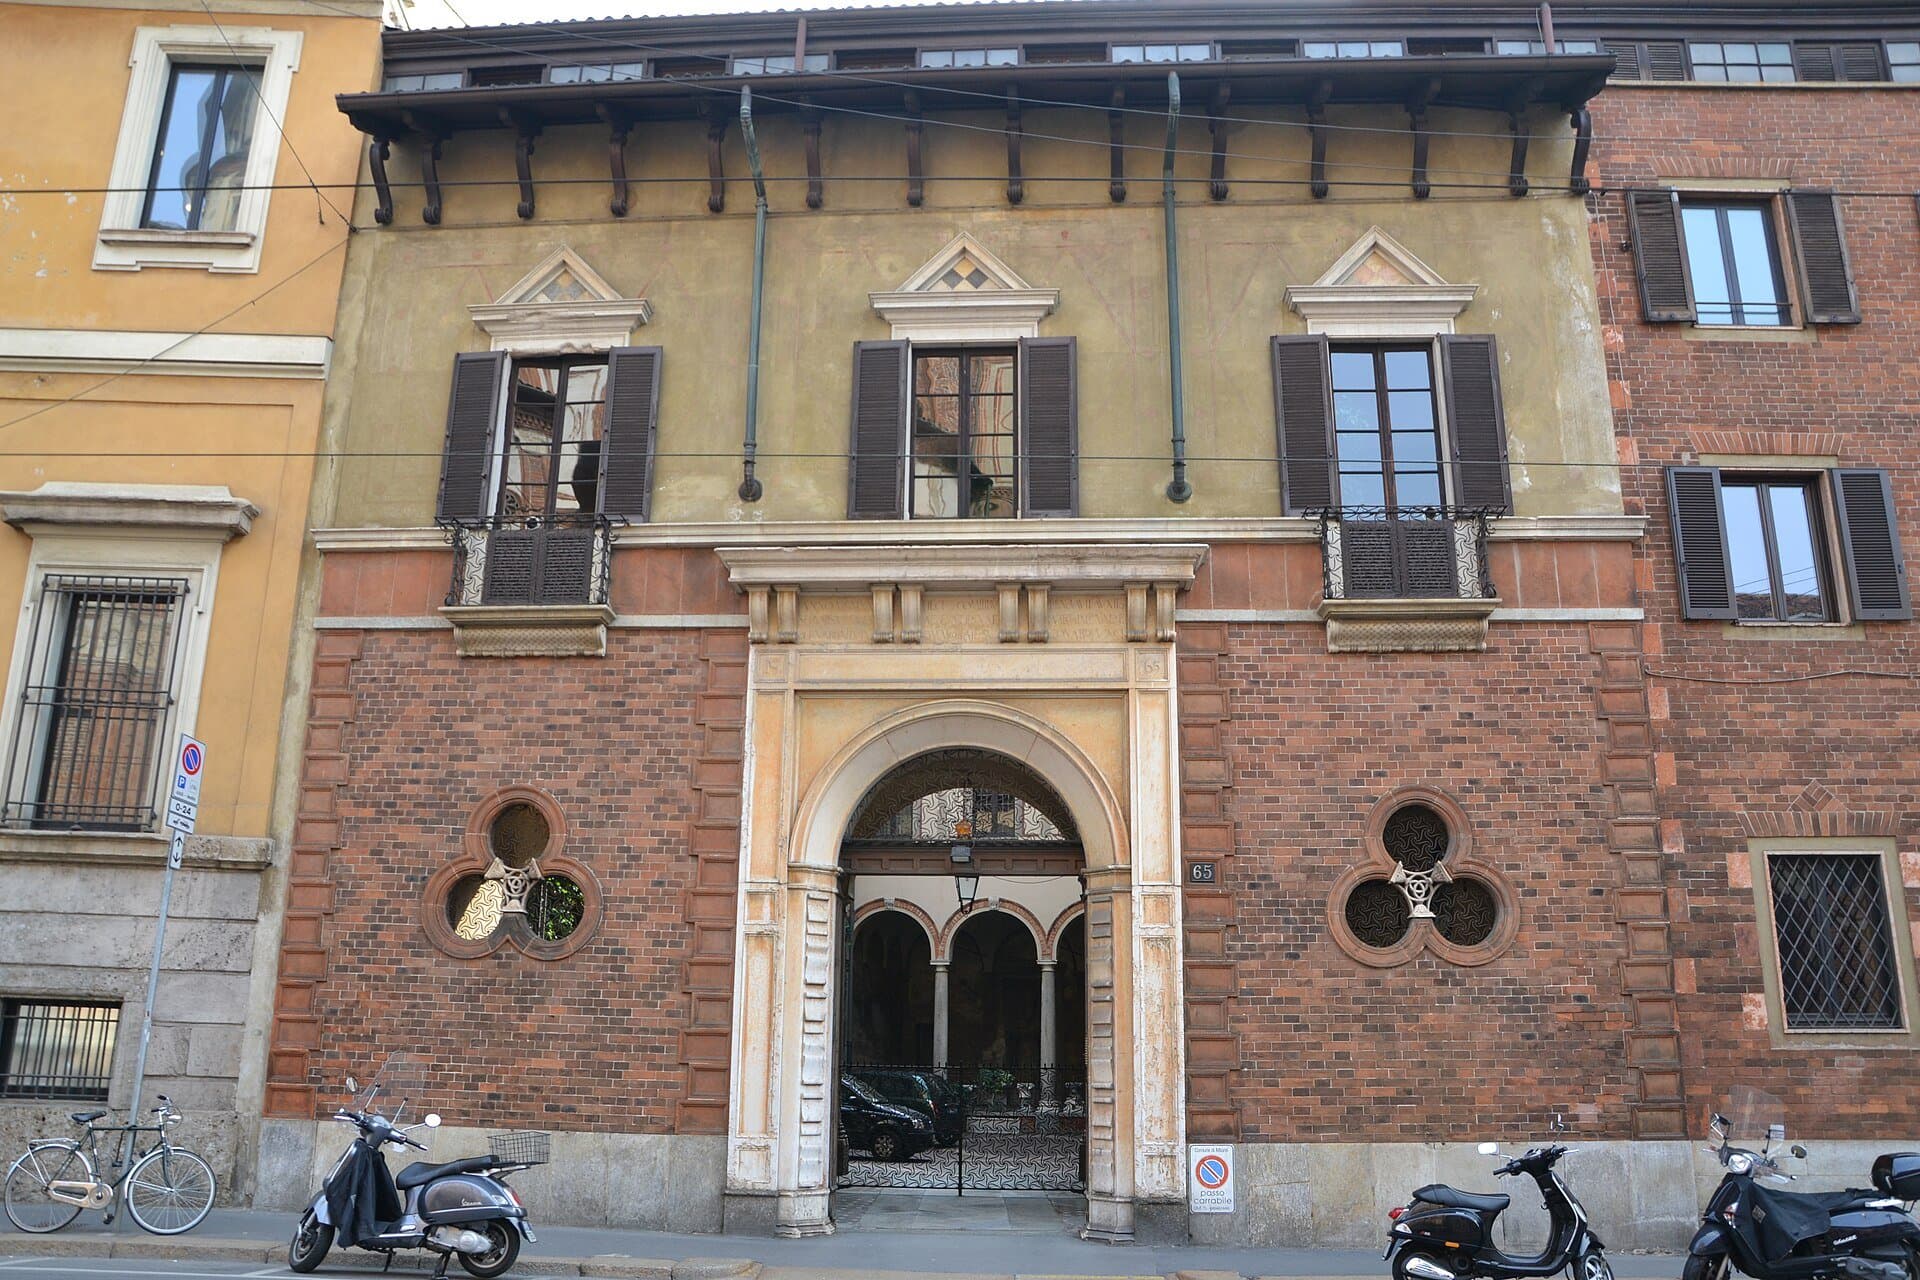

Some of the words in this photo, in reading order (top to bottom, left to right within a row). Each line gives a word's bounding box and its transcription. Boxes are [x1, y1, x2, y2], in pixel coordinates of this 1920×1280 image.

[175, 803, 191, 815] 0-24
[1193, 864, 1212, 880] 65
[1193, 1196, 1232, 1205] carrabile
